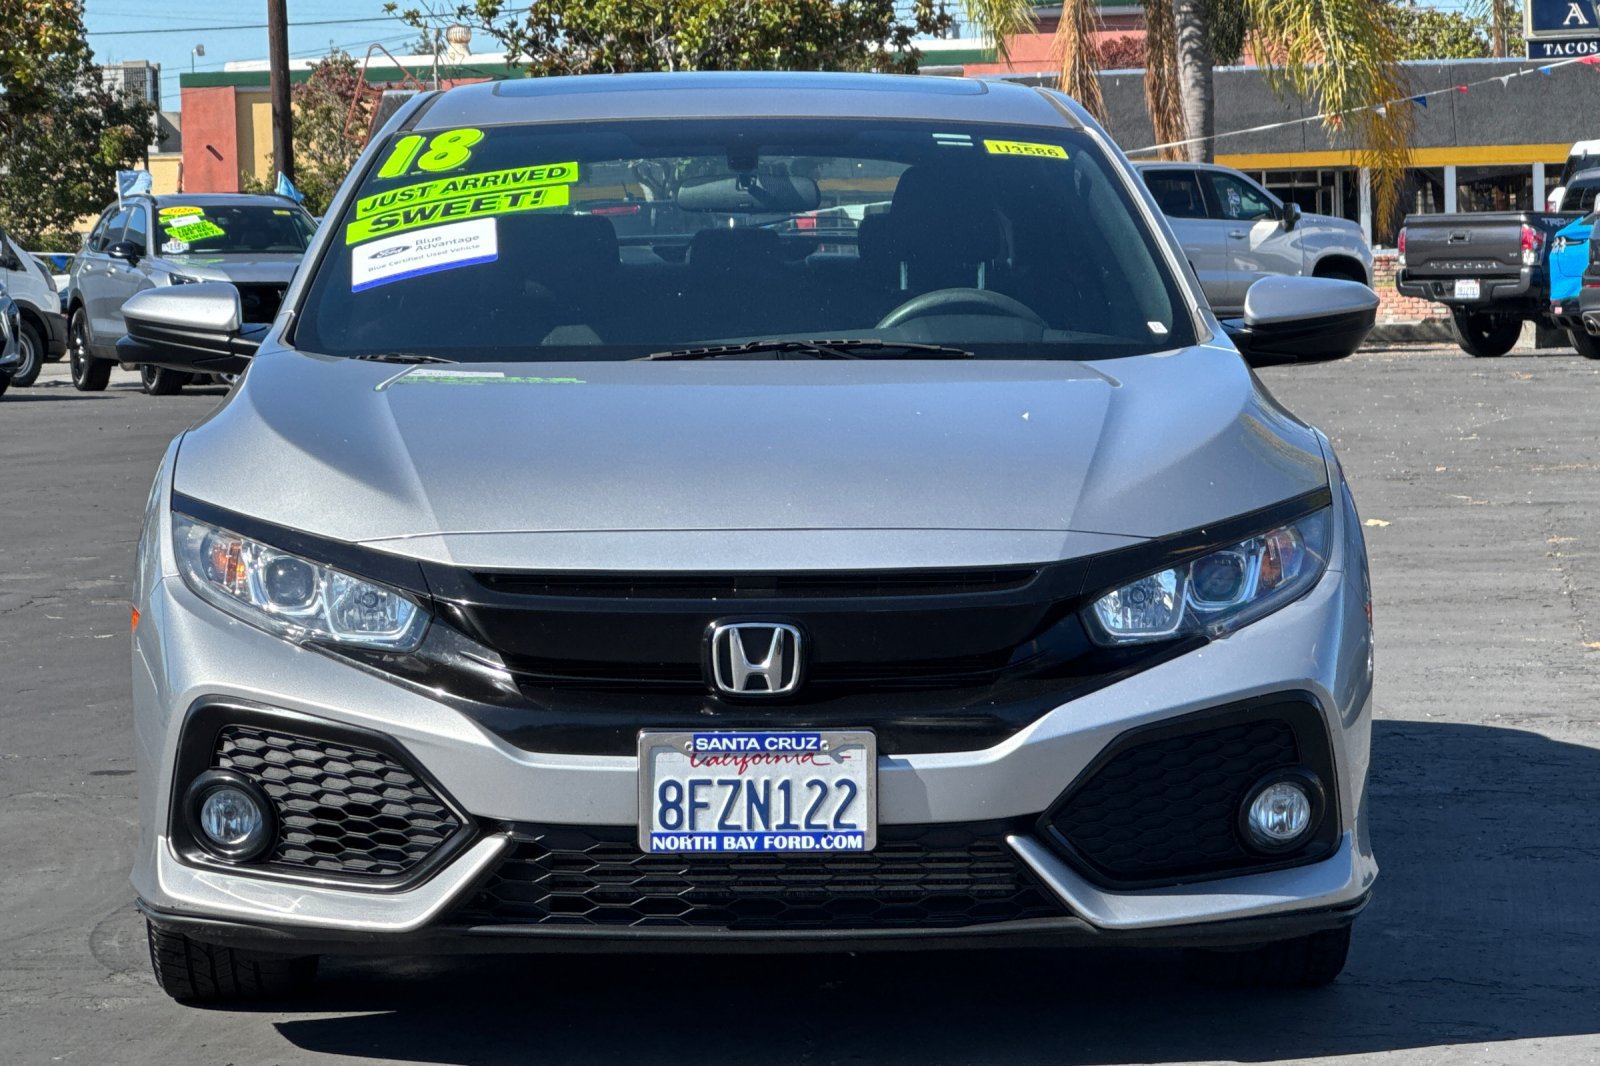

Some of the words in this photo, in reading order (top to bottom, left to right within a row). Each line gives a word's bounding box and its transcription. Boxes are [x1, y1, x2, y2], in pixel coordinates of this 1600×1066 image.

[1543, 41, 1598, 55] TACOS
[377, 128, 485, 178] 18
[362, 184, 438, 212] JUST
[440, 166, 570, 194] ARRIVED
[368, 189, 548, 233] SWEET!
[415, 235, 442, 246] Blue
[415, 235, 480, 252] Advantage
[368, 264, 387, 273] Blue
[389, 254, 424, 266] Certified
[426, 250, 448, 258] Used
[450, 244, 480, 253] Vehicle
[695, 737, 761, 750] SANTA
[764, 737, 818, 750] CRUZ
[690, 752, 830, 776] California
[658, 778, 858, 831] 8FZN122
[652, 836, 720, 850] NORTH
[723, 836, 758, 850] BAY
[764, 834, 863, 849] FORD.COM
